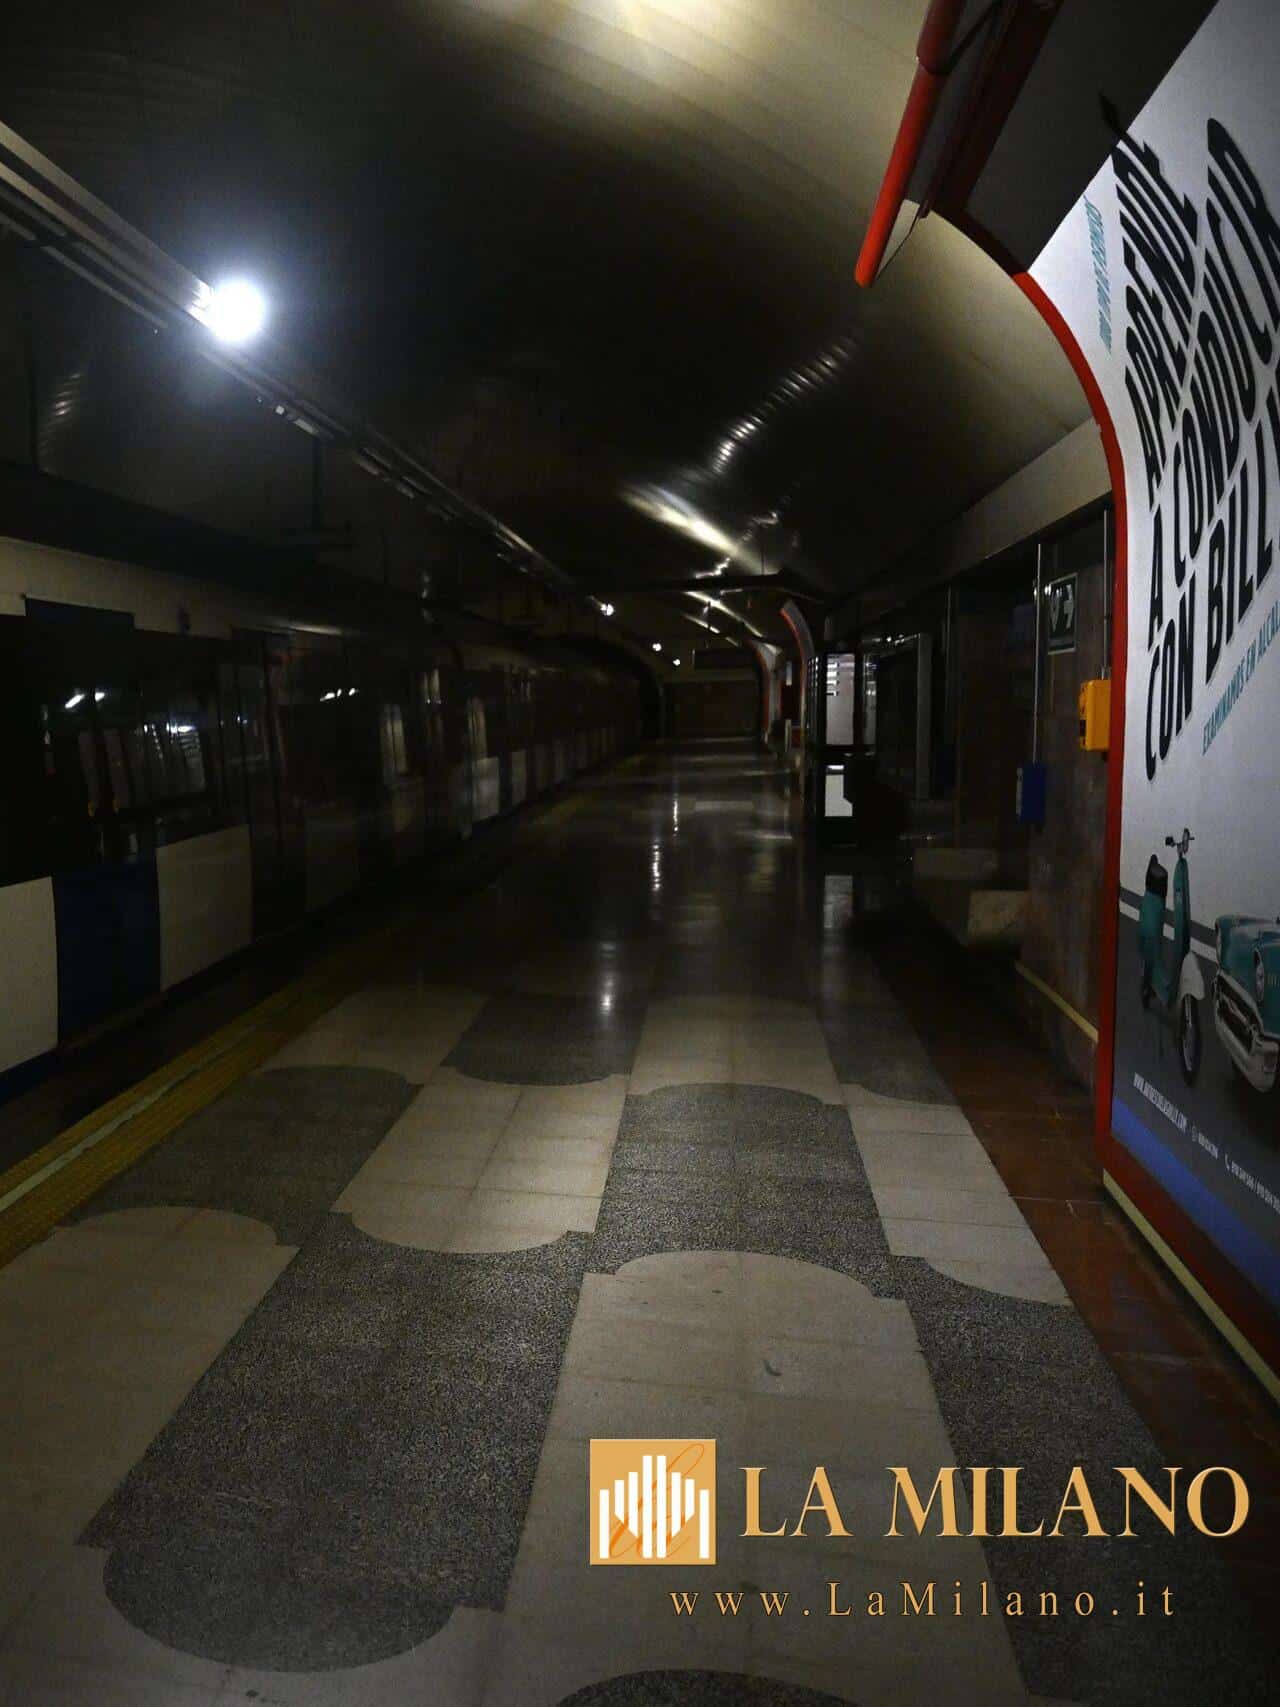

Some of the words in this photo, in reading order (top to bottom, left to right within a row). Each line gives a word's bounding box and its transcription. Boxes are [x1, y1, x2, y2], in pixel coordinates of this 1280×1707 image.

[1148, 504, 1163, 651] A
[1174, 117, 1280, 588] CONDUCIR
[1145, 570, 1196, 781] CON
